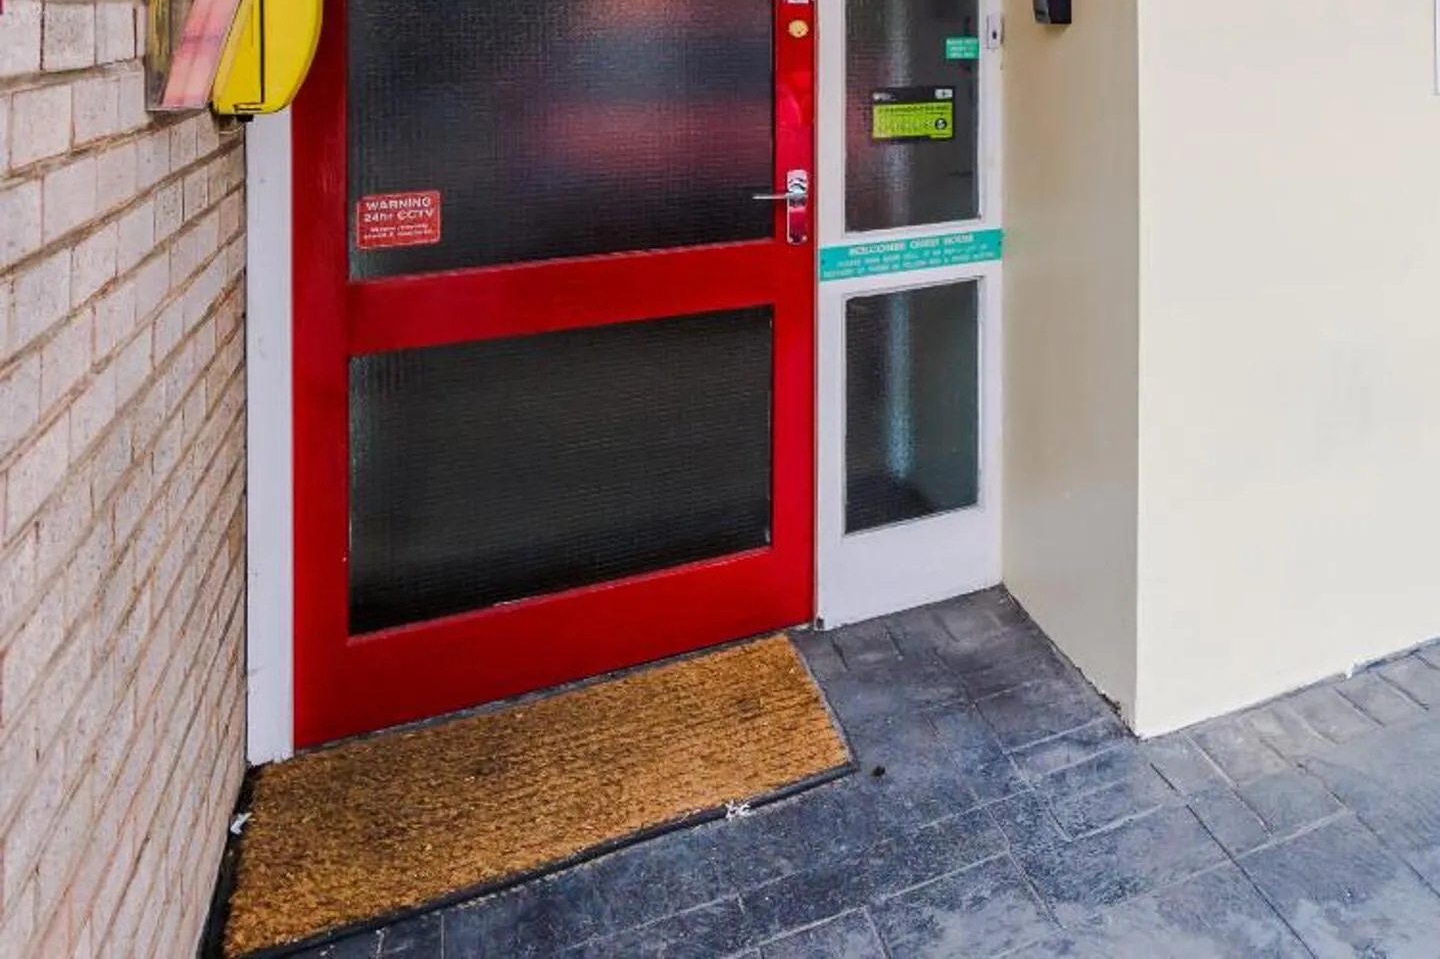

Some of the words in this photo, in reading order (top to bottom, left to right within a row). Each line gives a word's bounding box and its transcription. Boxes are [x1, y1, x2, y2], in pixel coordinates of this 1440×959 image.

[367, 197, 431, 210] WARNING
[364, 213, 392, 222] 24hr
[397, 209, 434, 220] CCTV
